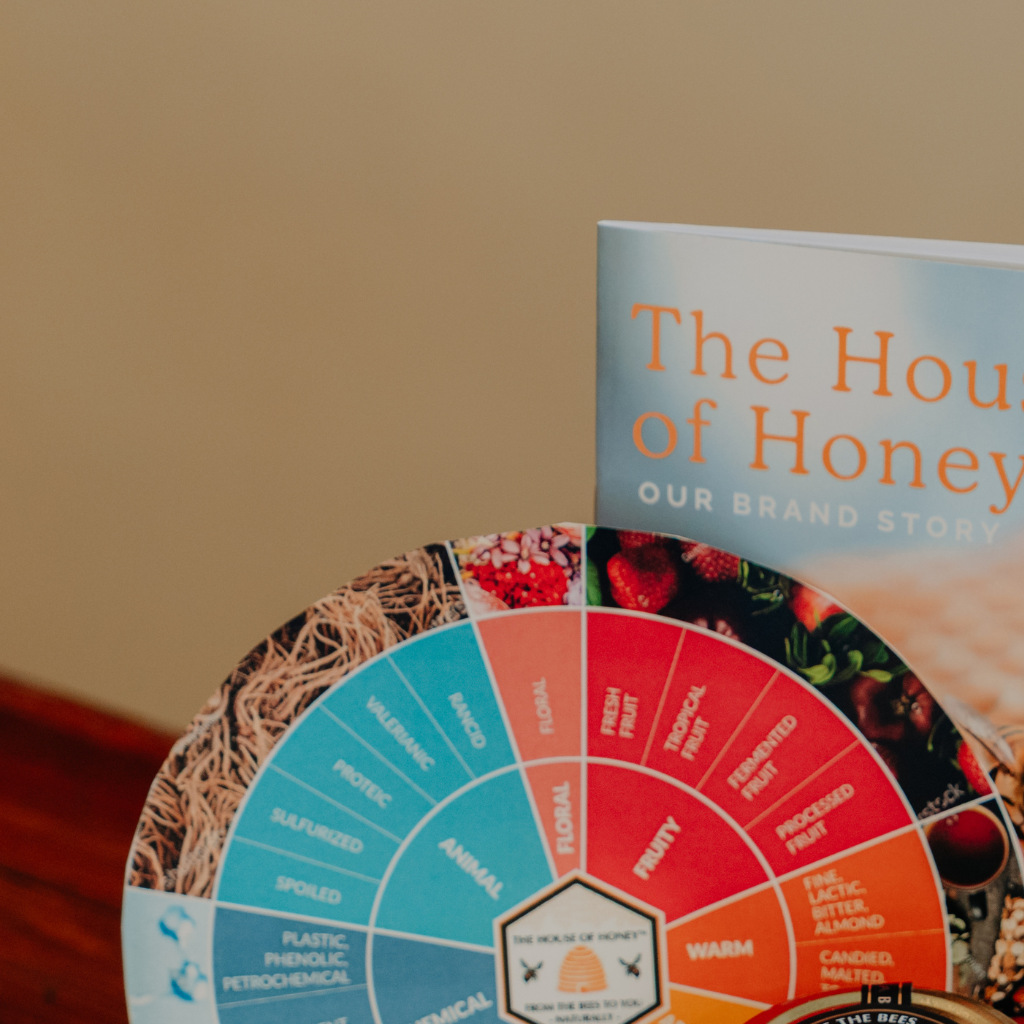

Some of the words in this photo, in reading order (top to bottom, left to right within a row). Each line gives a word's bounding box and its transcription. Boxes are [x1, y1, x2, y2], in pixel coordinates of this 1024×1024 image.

[631, 303, 789, 384] The
[632, 399, 717, 463] of
[638, 481, 714, 512] OUR
[733, 493, 858, 528] BRAND
[877, 510, 1001, 545] STORY
[365, 695, 435, 772] VALERIANIC
[448, 692, 487, 750] RANCID
[532, 677, 555, 735] FLORAL
[601, 687, 621, 736] FRESH
[619, 692, 639, 739] FRUIT
[663, 685, 707, 752] TROPICAL
[681, 716, 710, 761] FRUIT
[726, 714, 798, 790] FERMENTED
[332, 759, 392, 809] PROTEIC
[741, 760, 779, 802] FRUIT
[271, 807, 364, 854] SULFURIZED
[553, 781, 575, 855] FLORAL
[775, 783, 855, 841] PROCESSED
[785, 819, 829, 856] FRUIT
[439, 837, 504, 899] ANIMAL
[632, 815, 682, 880] FRUITY
[275, 875, 342, 905] SPOILED
[686, 939, 754, 961] WARM
[814, 914, 886, 937] ALMOND
[222, 969, 352, 993] PETROCHEMICAL
